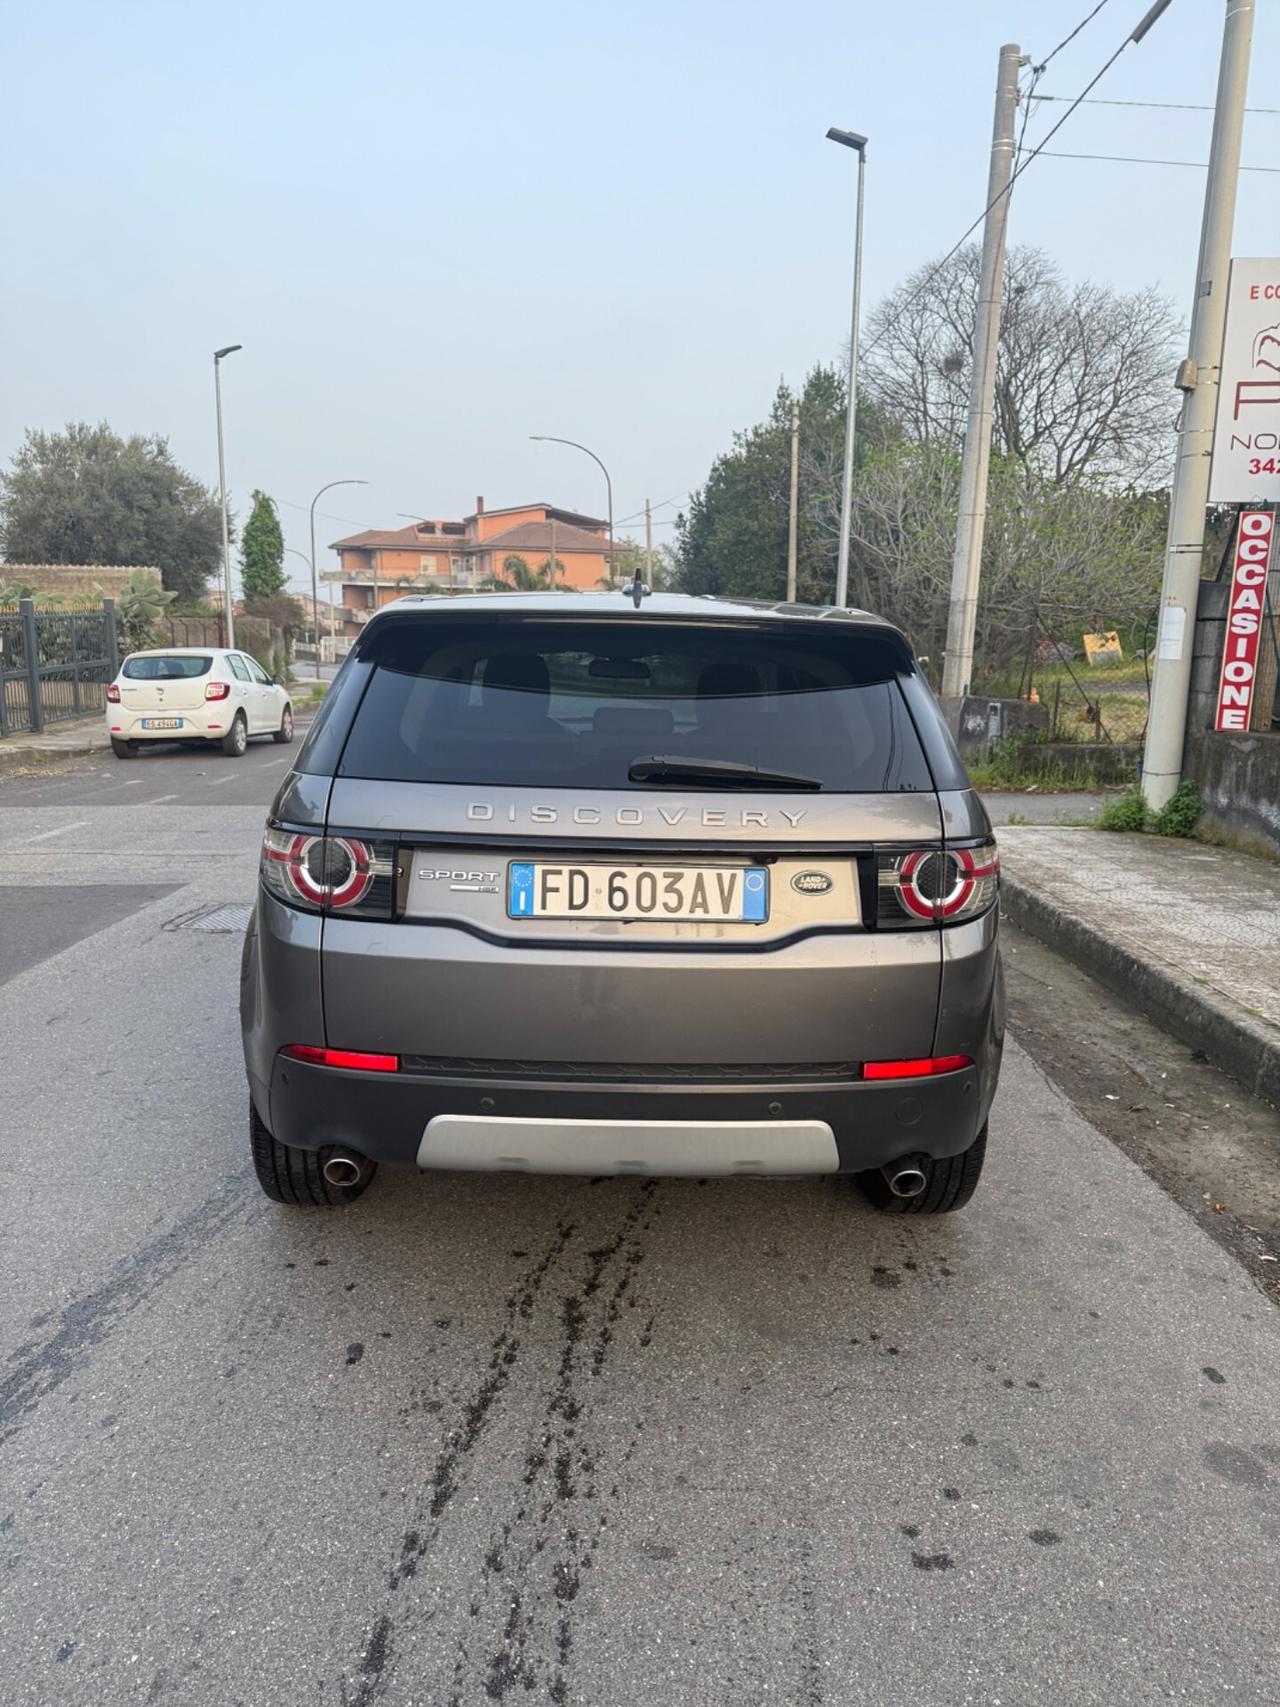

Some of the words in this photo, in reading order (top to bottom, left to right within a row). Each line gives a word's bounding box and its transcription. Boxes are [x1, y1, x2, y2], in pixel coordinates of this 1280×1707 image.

[1250, 285, 1260, 300] E
[1230, 433, 1280, 450] NO
[1221, 514, 1272, 730] OCCASIONE
[467, 802, 808, 828] DISCOVERY
[419, 869, 499, 882] SPORT
[540, 869, 589, 911] FD
[608, 870, 738, 914] 603AV
[802, 882, 828, 890] ROVER
